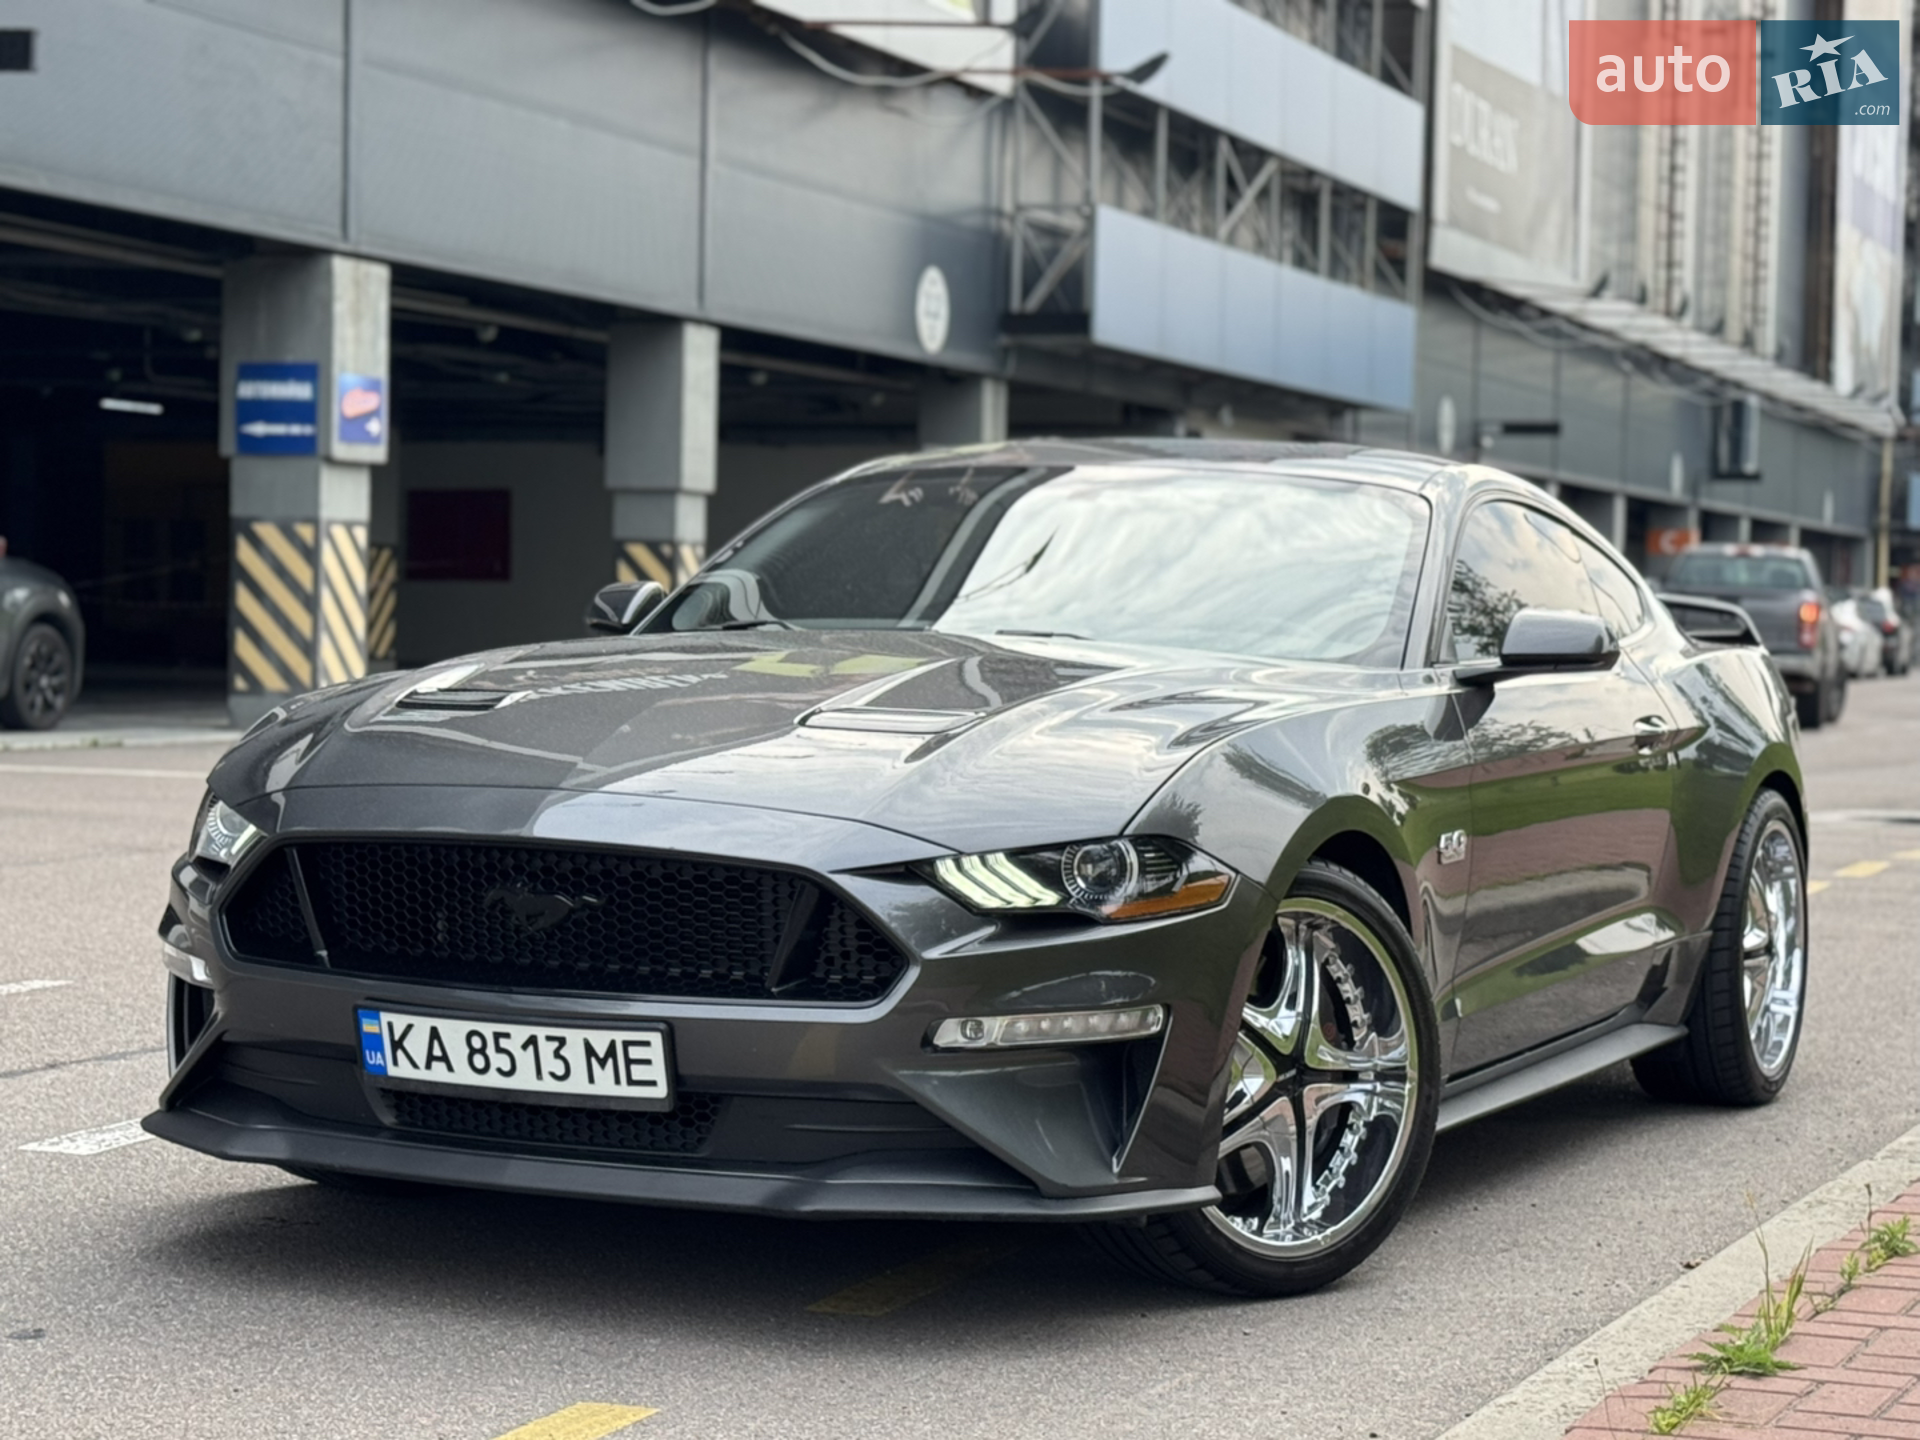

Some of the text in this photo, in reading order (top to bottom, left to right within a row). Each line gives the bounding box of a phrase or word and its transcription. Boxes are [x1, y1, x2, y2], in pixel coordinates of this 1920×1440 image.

[365, 1049, 385, 1066] UA
[387, 1021, 658, 1087] KA 8513 ME
